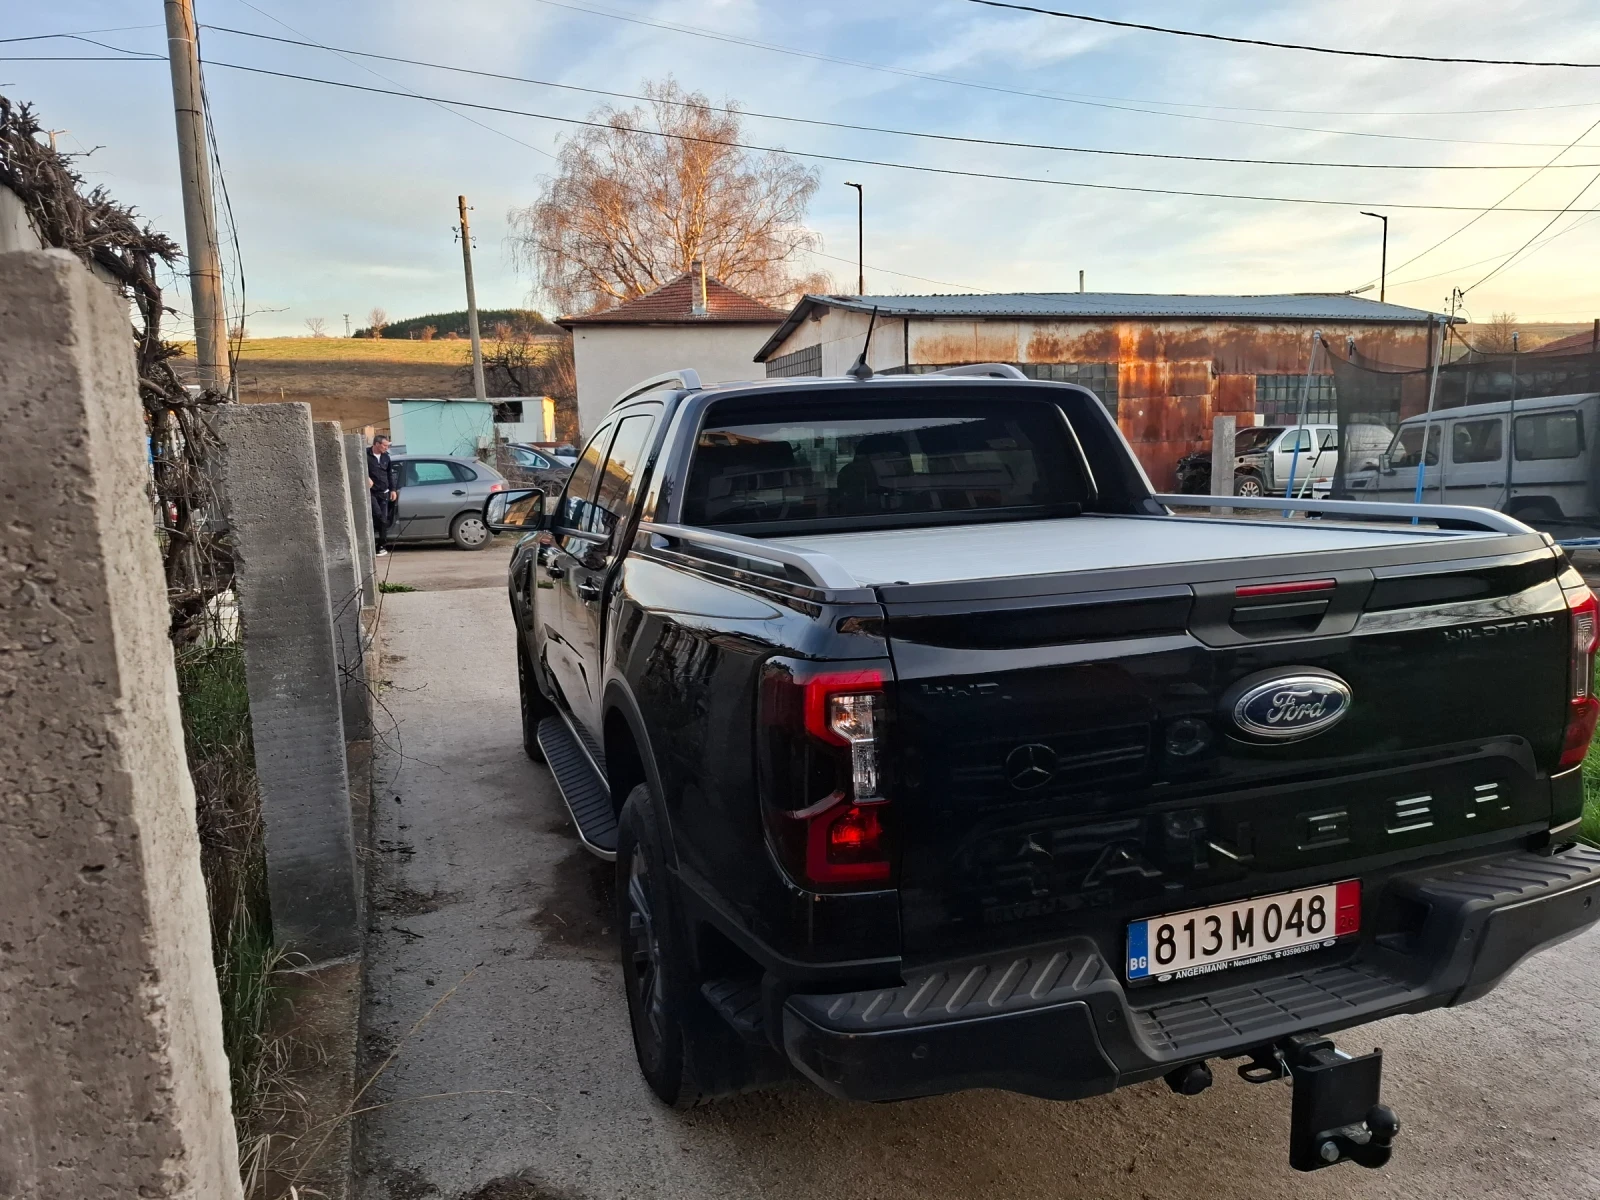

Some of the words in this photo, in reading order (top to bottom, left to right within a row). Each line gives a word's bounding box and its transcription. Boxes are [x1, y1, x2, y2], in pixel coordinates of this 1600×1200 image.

[1443, 616, 1555, 641] WILDTRAK
[1266, 689, 1329, 724] Ford
[990, 778, 1512, 897] RANGER
[1130, 956, 1147, 971] BG
[1175, 961, 1228, 980] ANGERMANN
